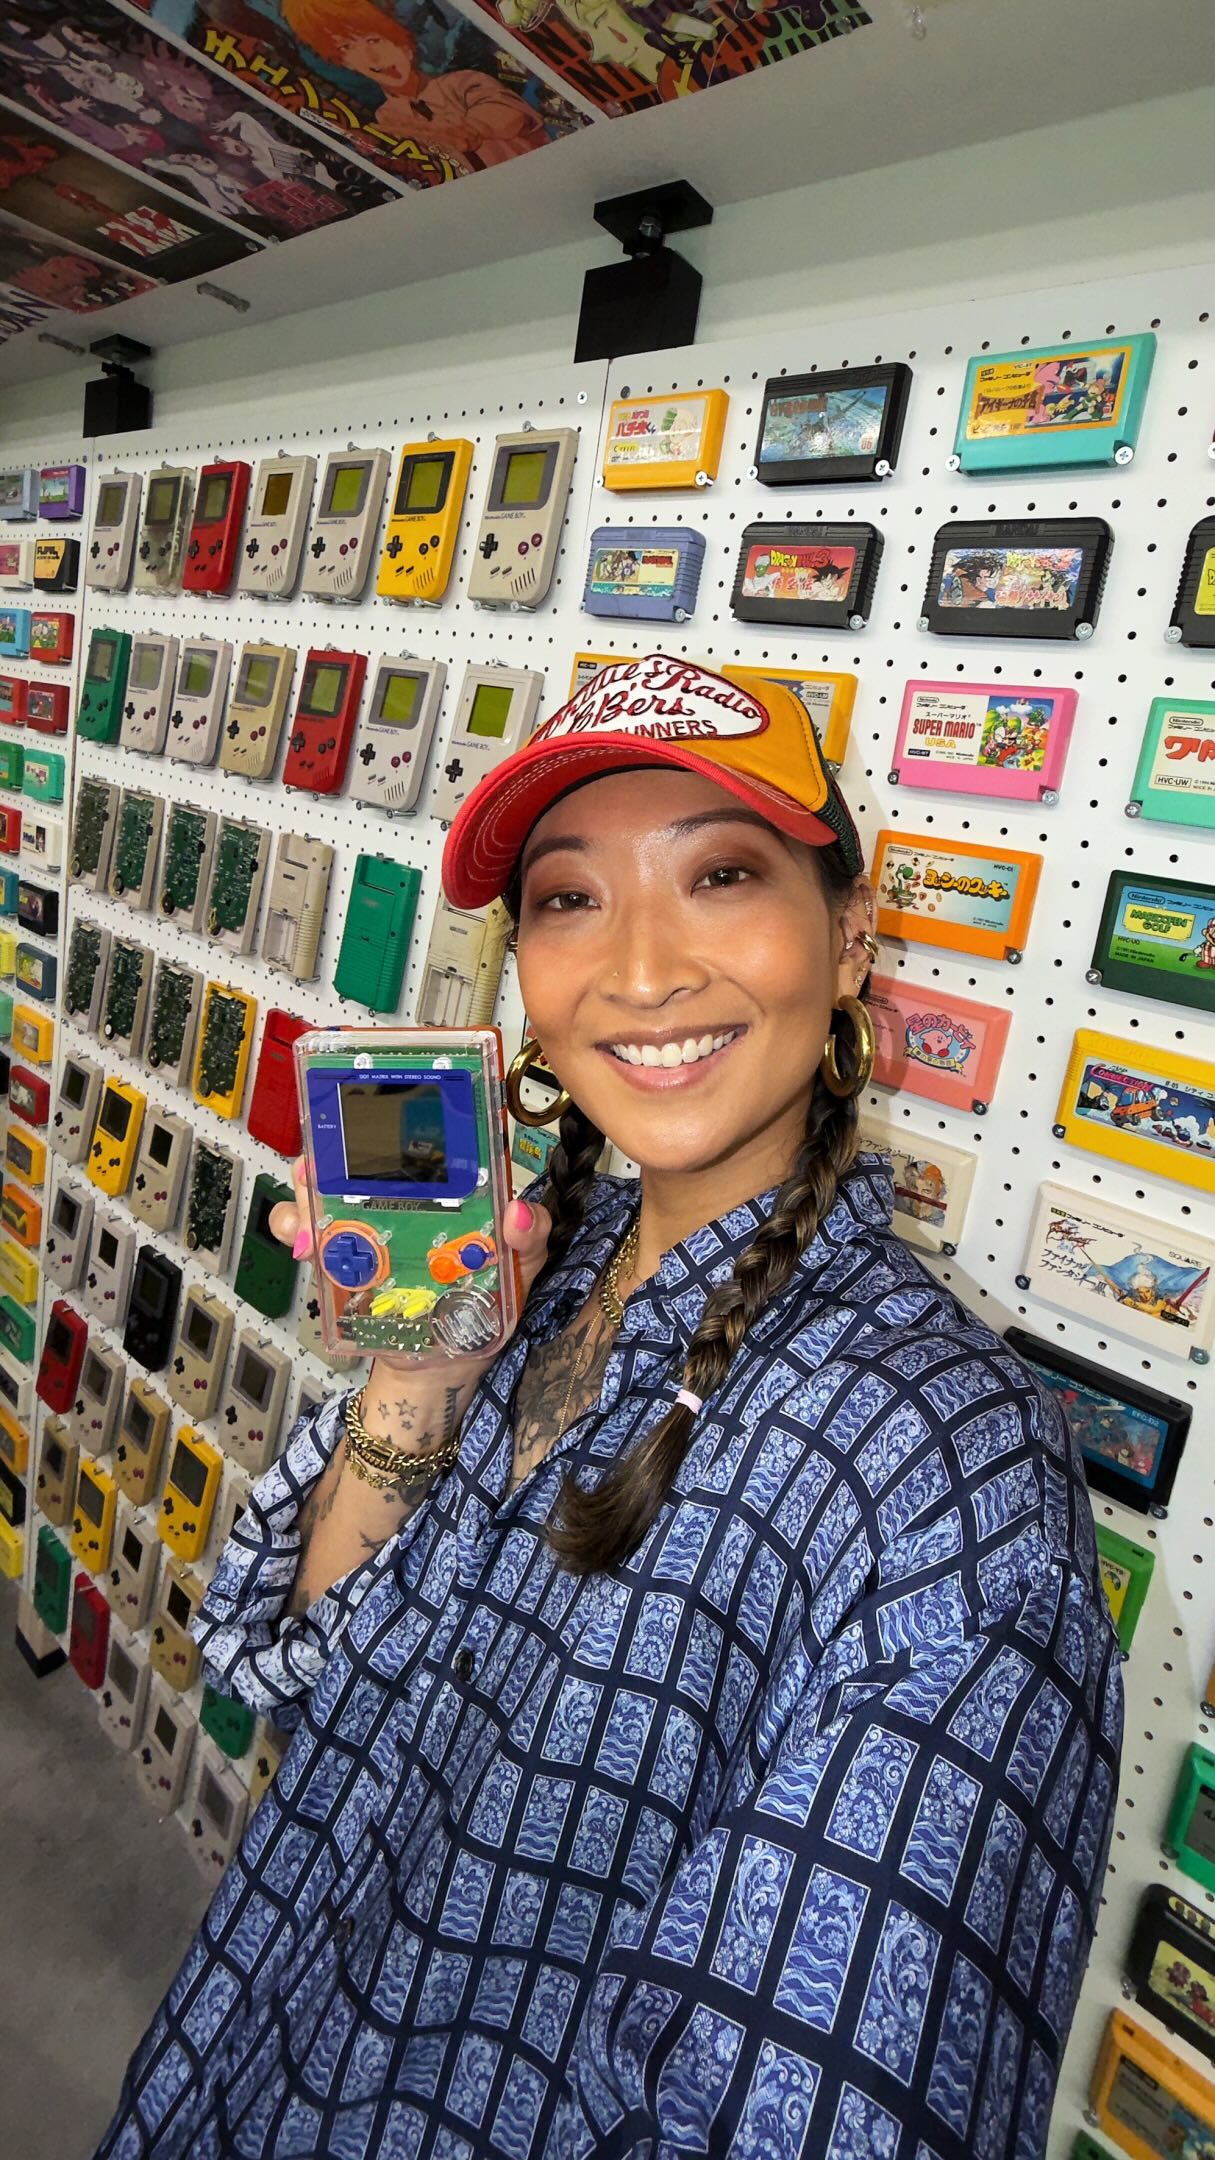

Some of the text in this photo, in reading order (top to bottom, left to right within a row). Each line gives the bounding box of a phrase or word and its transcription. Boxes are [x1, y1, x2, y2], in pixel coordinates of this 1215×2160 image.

[642, 664, 761, 719] Radio
[912, 718, 976, 740] SUPER MARIO
[925, 738, 956, 750] USA
[1157, 777, 1189, 786] HVC-UW
[923, 868, 1011, 902] ヨッシーのクッキー
[362, 1200, 421, 1211] GAME BOY
[1168, 1250, 1203, 1268] SQUARE
